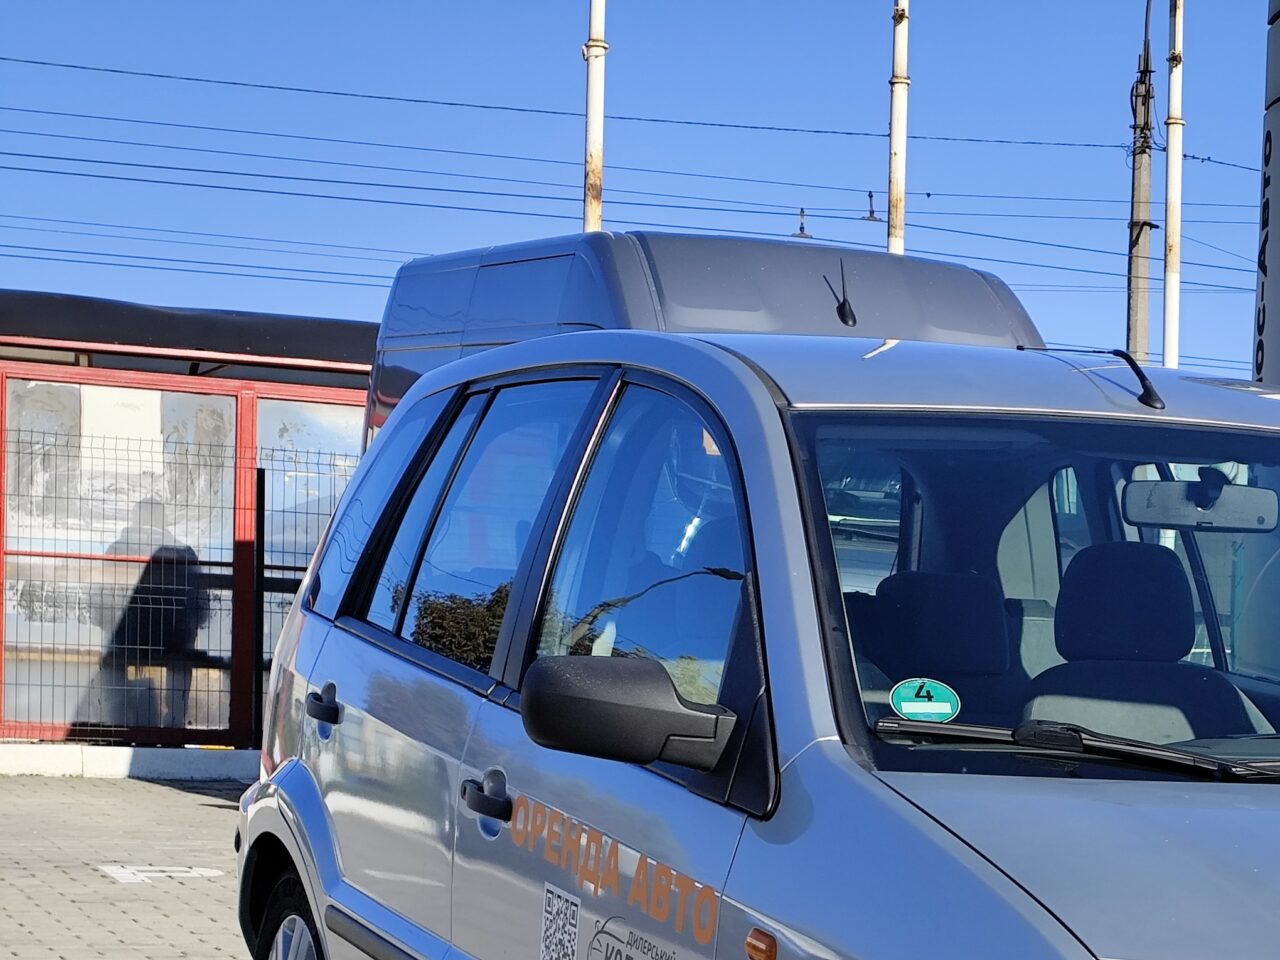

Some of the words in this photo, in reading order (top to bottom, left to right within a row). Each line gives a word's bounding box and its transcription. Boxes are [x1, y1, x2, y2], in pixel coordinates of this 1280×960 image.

[1256, 130, 1272, 383] ОС-АВТО
[914, 682, 934, 702] 4
[511, 795, 620, 897] ОРЕНДА
[627, 853, 718, 945] АВТО
